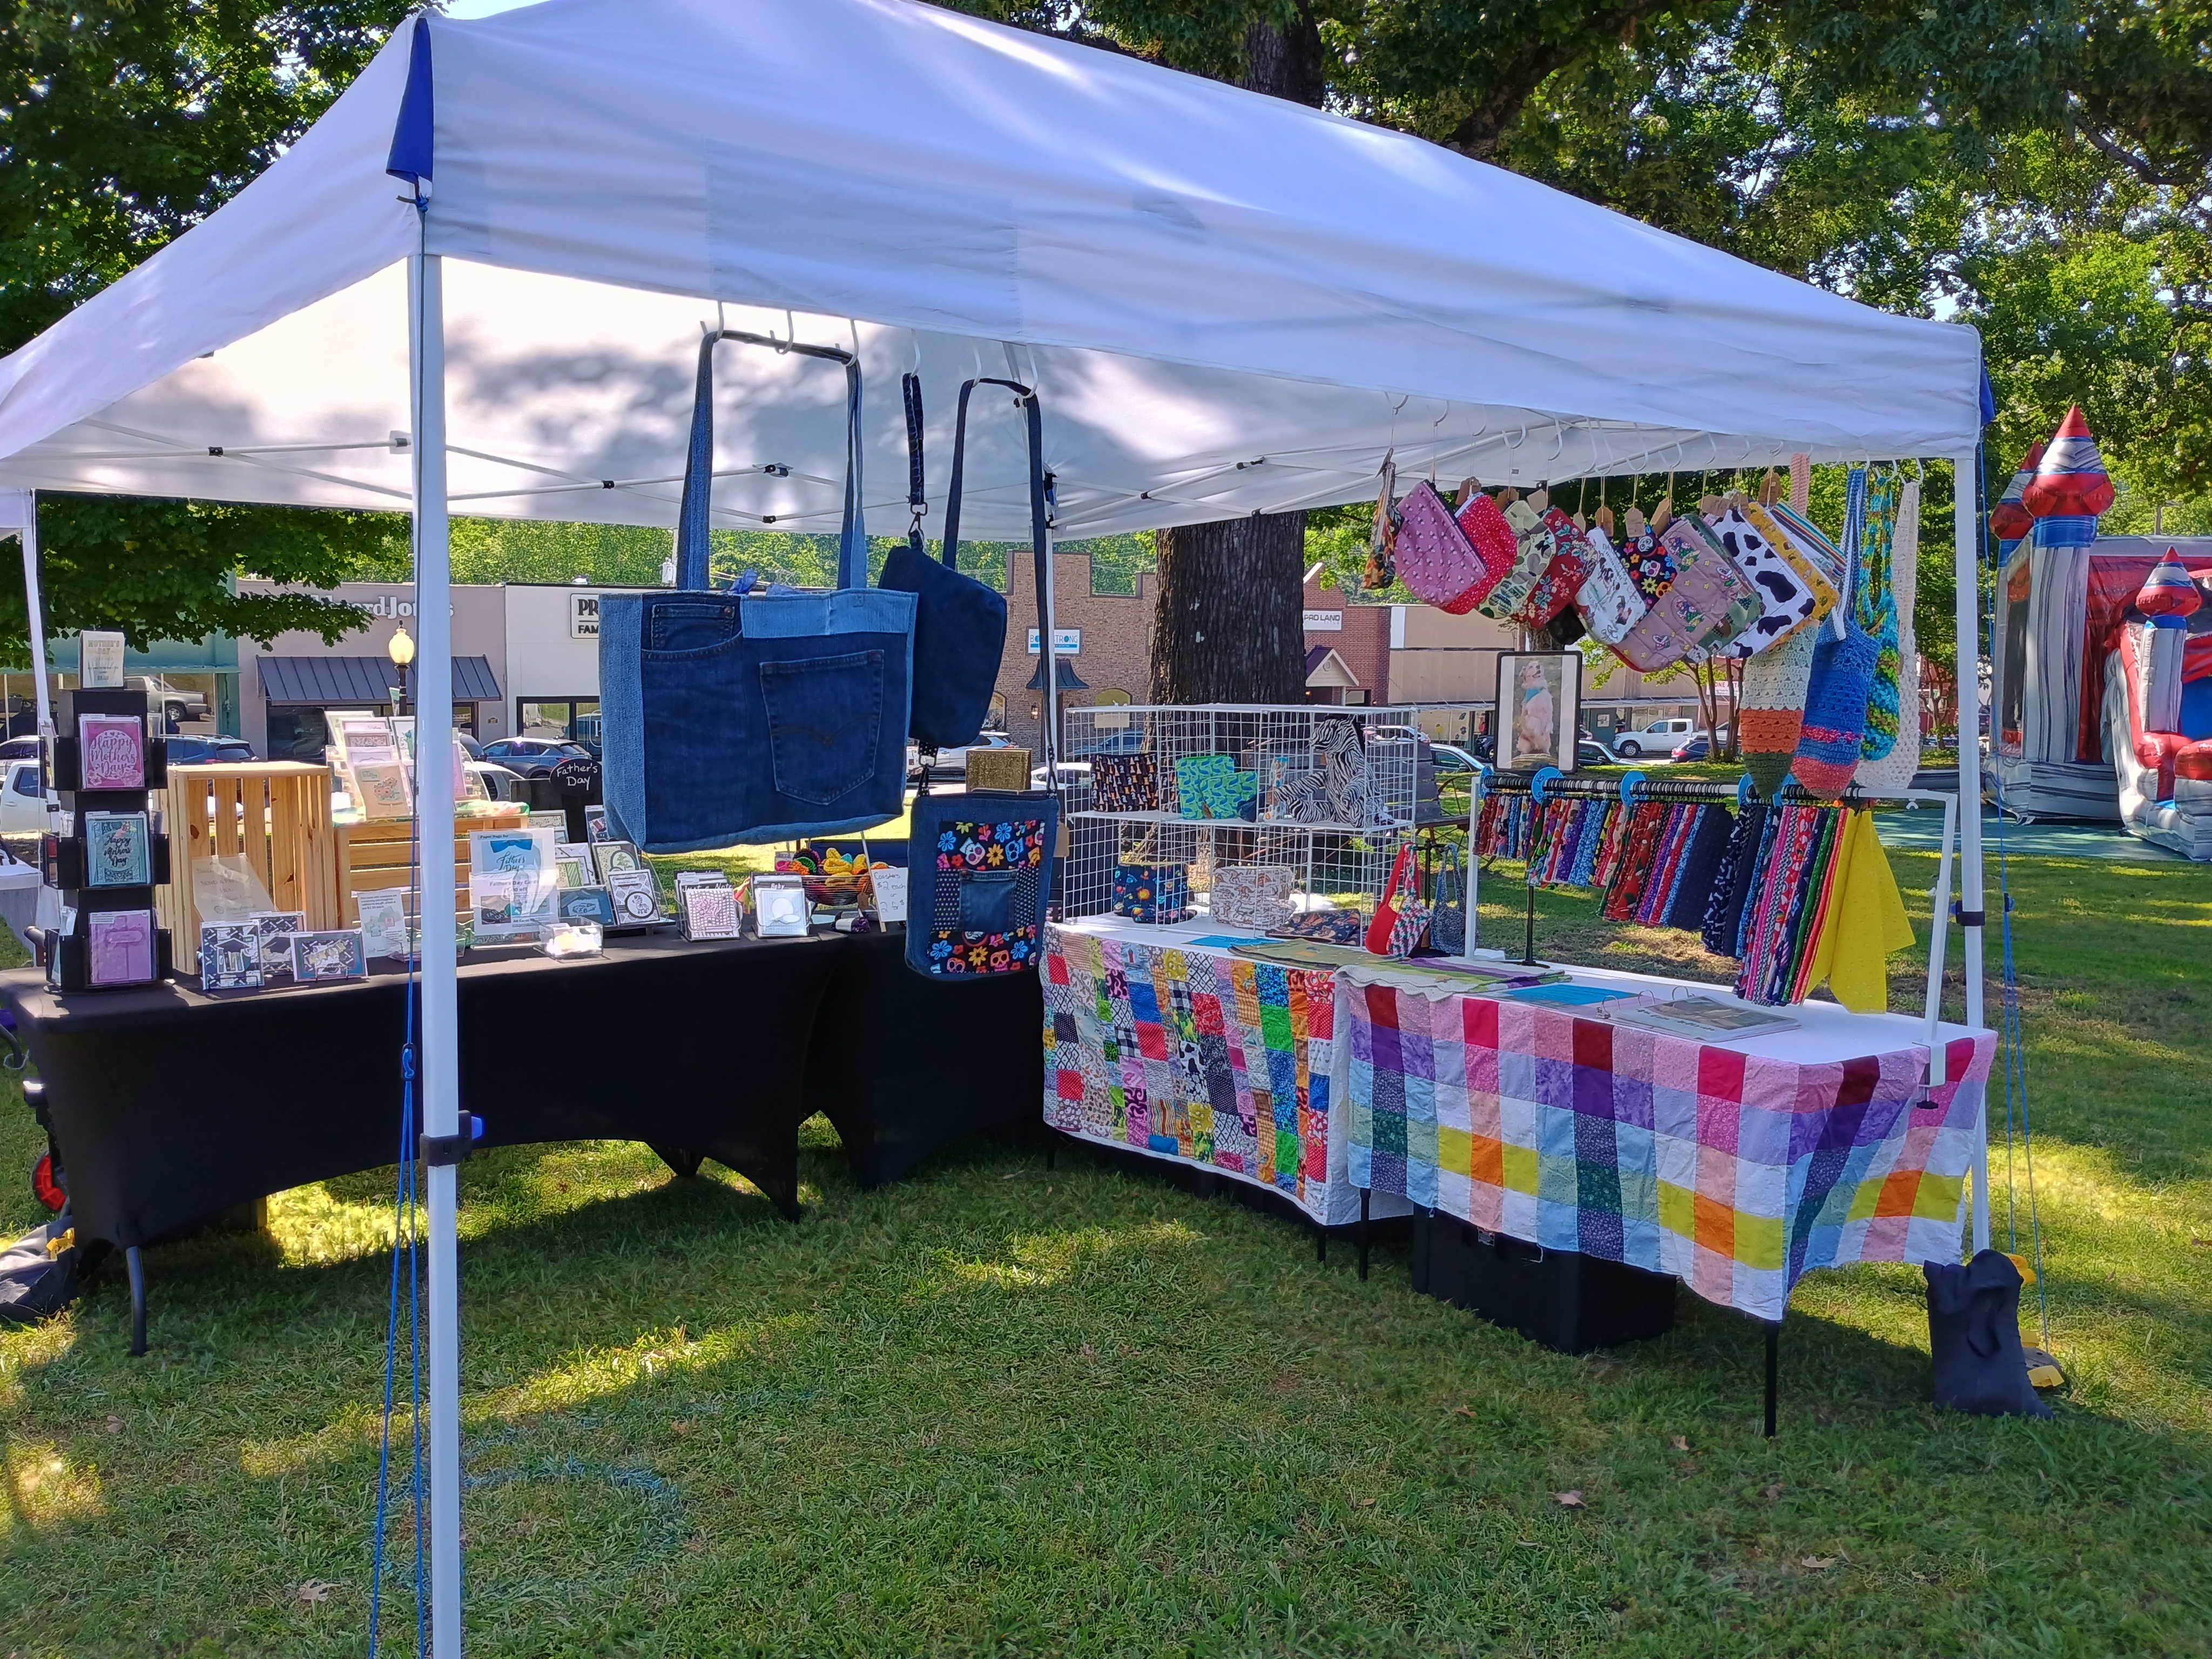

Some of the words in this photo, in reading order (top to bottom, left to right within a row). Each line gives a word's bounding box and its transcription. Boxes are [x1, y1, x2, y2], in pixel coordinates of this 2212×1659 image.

[91, 736, 132, 754] Happy
[100, 761, 127, 776] Day
[557, 763, 598, 778] Father's
[567, 776, 590, 791] Day
[104, 832, 131, 848] Happy
[111, 856, 127, 867] Day
[874, 872, 900, 880] Coasters
